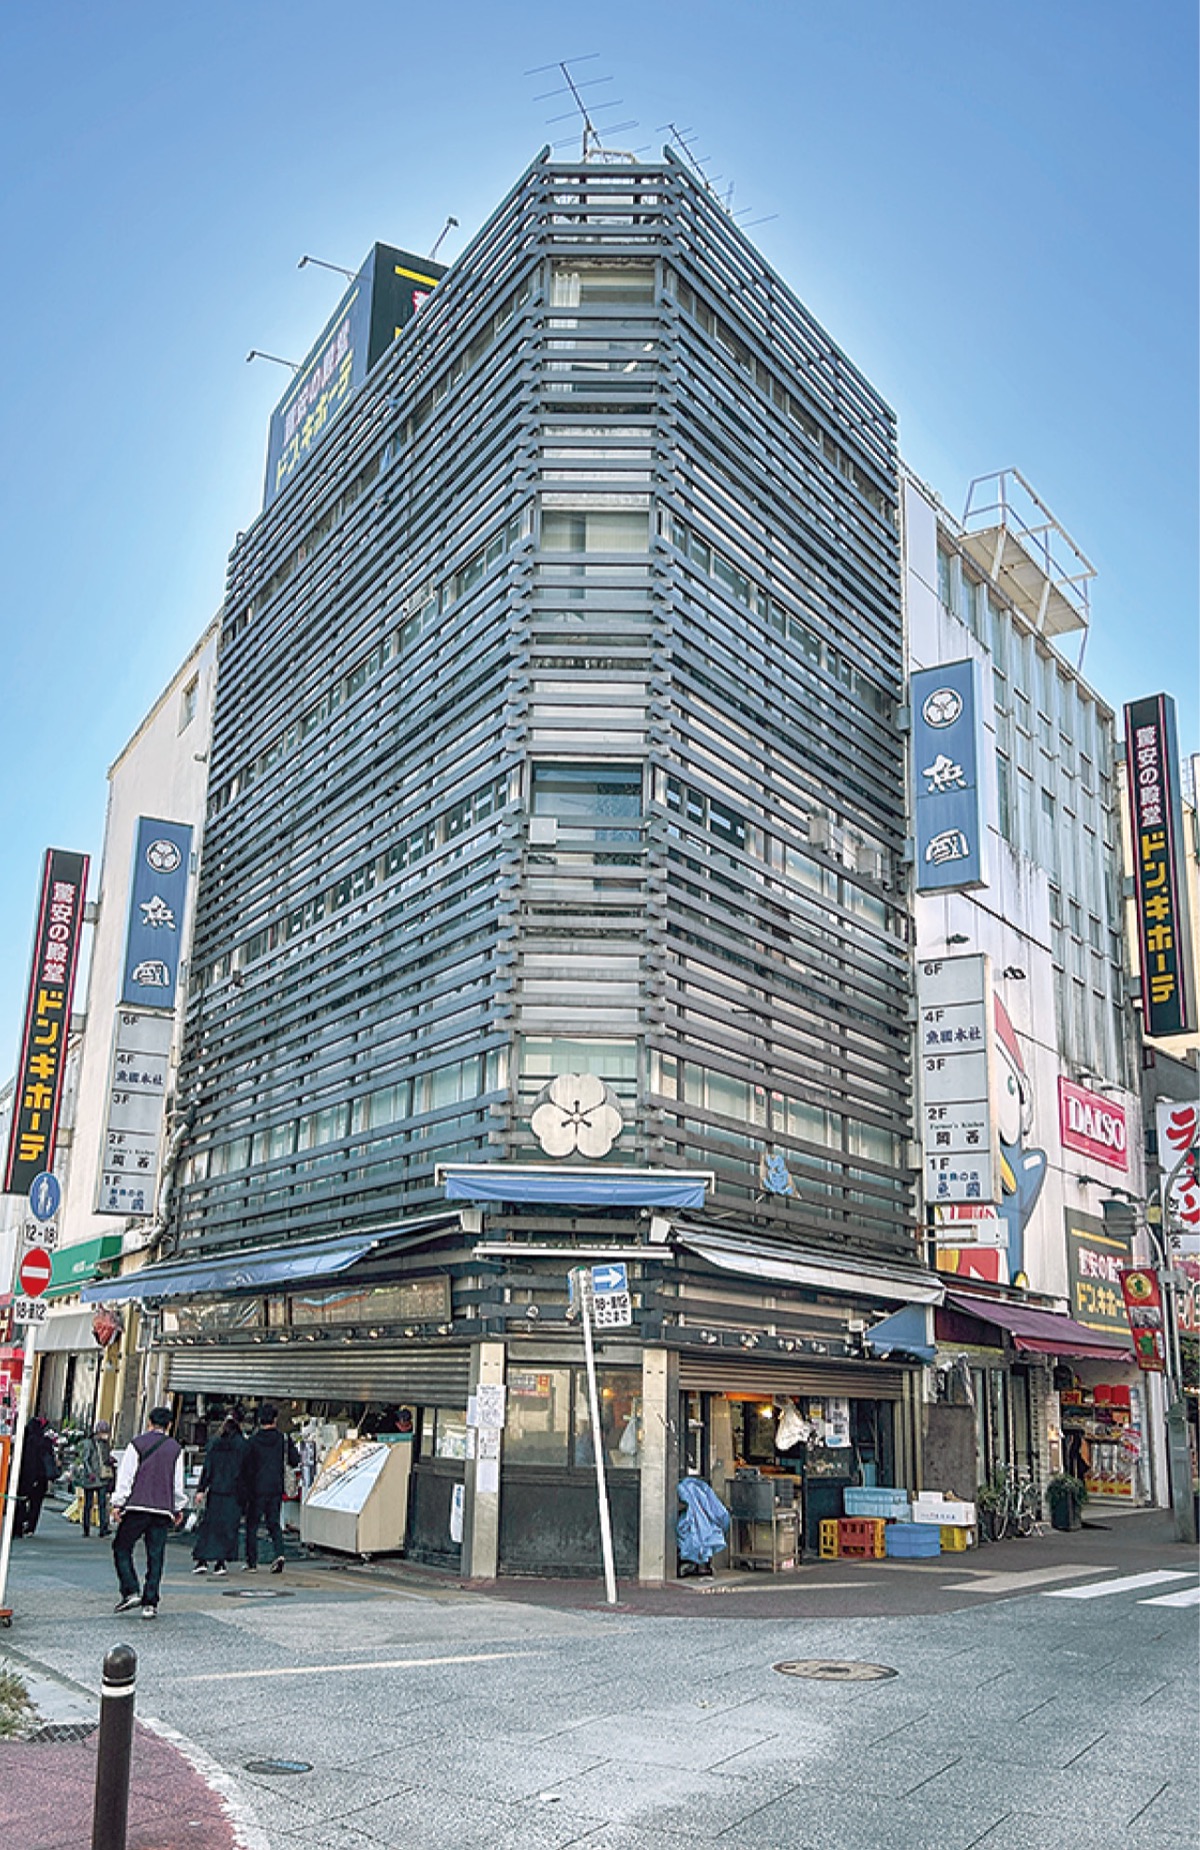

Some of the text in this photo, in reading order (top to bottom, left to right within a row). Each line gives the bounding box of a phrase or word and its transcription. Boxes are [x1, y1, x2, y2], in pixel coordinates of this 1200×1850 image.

[923, 962, 943, 976] 6F
[924, 1010, 944, 1023] 4F
[117, 1053, 135, 1064] 4F
[926, 1059, 946, 1072] 3F
[113, 1093, 130, 1105] 3F
[927, 1108, 948, 1120] 2F
[1068, 1098, 1125, 1151] DAISO
[109, 1134, 125, 1145] 2F
[930, 1158, 950, 1171] 1F
